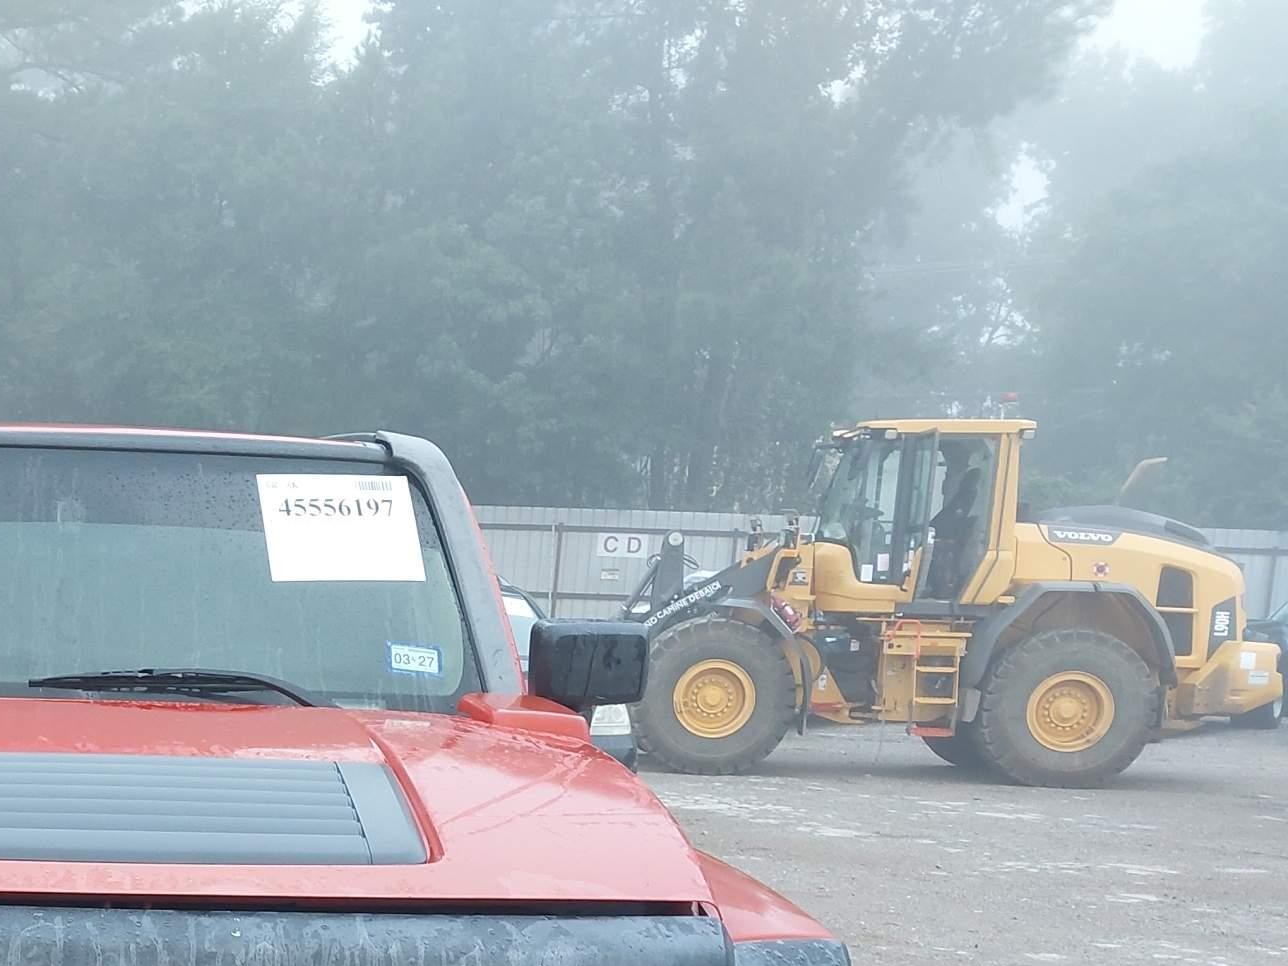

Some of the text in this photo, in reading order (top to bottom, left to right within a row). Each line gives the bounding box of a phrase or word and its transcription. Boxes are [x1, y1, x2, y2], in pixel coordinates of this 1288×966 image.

[279, 498, 393, 517] 45556197
[604, 536, 642, 553] C D
[1053, 530, 1113, 542] VOLVO
[1213, 611, 1231, 636] L90H
